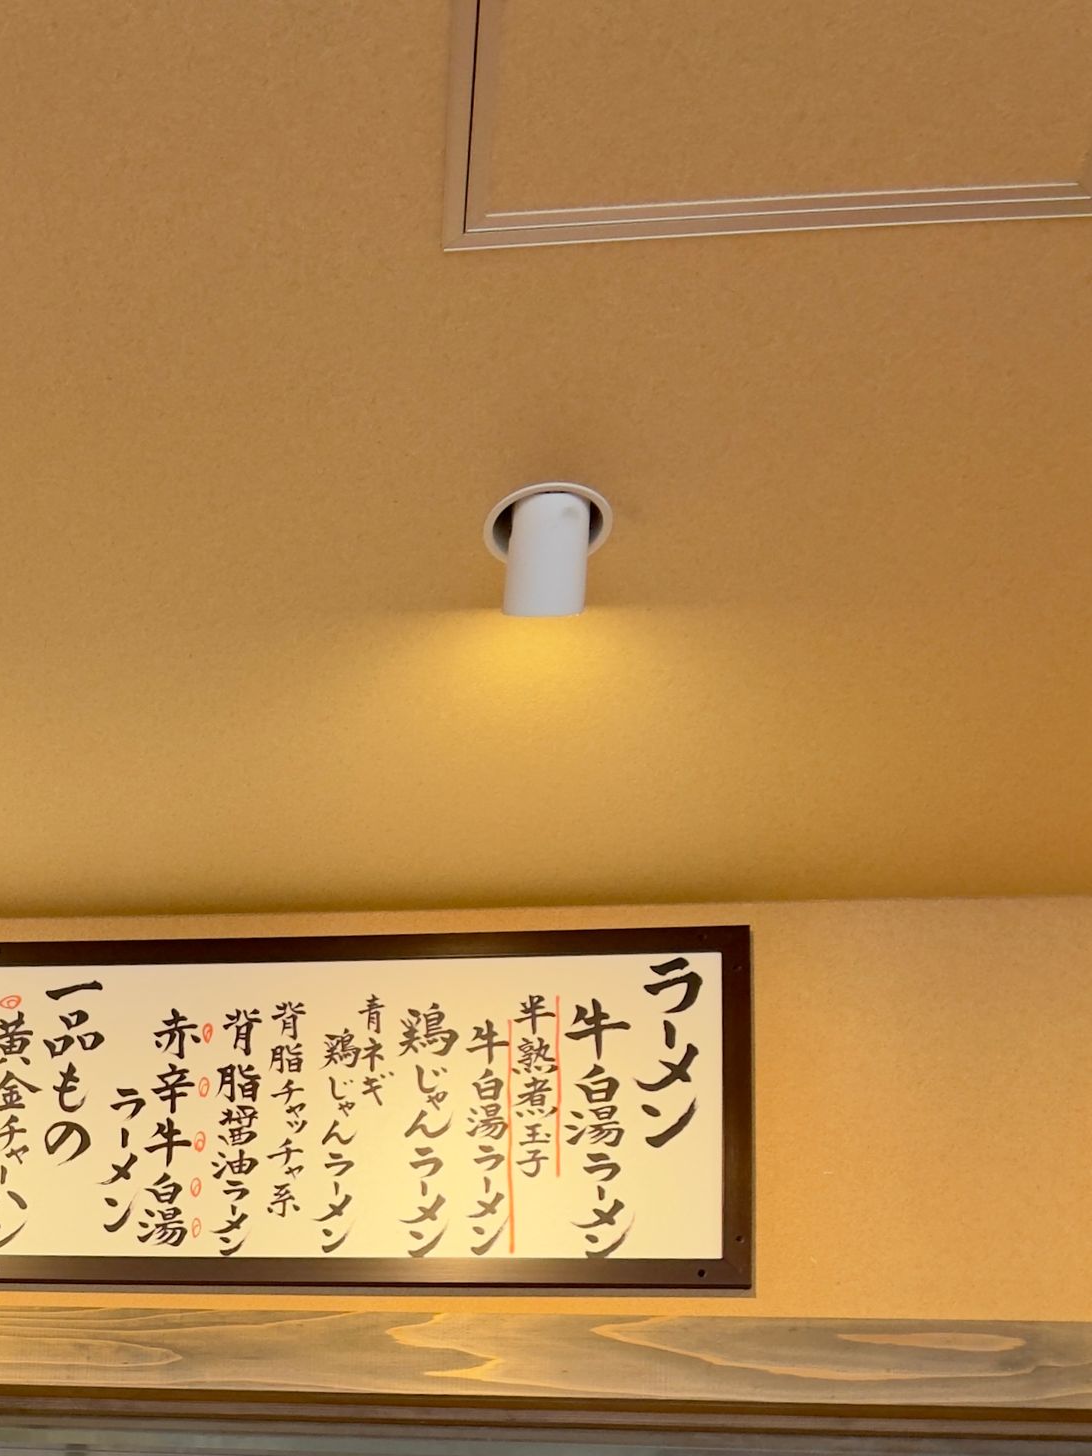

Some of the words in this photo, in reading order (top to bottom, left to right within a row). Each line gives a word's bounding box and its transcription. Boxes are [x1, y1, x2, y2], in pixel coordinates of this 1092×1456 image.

[43, 979, 105, 1166] 一品もの
[211, 1008, 263, 1256] 背脂醤油ラーメン
[266, 1002, 306, 1216] 背脂チャッチャ系
[312, 1028, 364, 1253] 鶏じゃんラーメン
[357, 993, 395, 1107] 青ネギ
[398, 1002, 459, 1258] 鶏じゃんラーメン
[466, 1019, 510, 1255] 牛白湯ラーメン
[511, 993, 557, 1178] 半熟煮玉子
[565, 999, 635, 1259] 牛白湯ラーメン
[637, 956, 704, 1148] ラーメン
[103, 1087, 147, 1233] ラーメン
